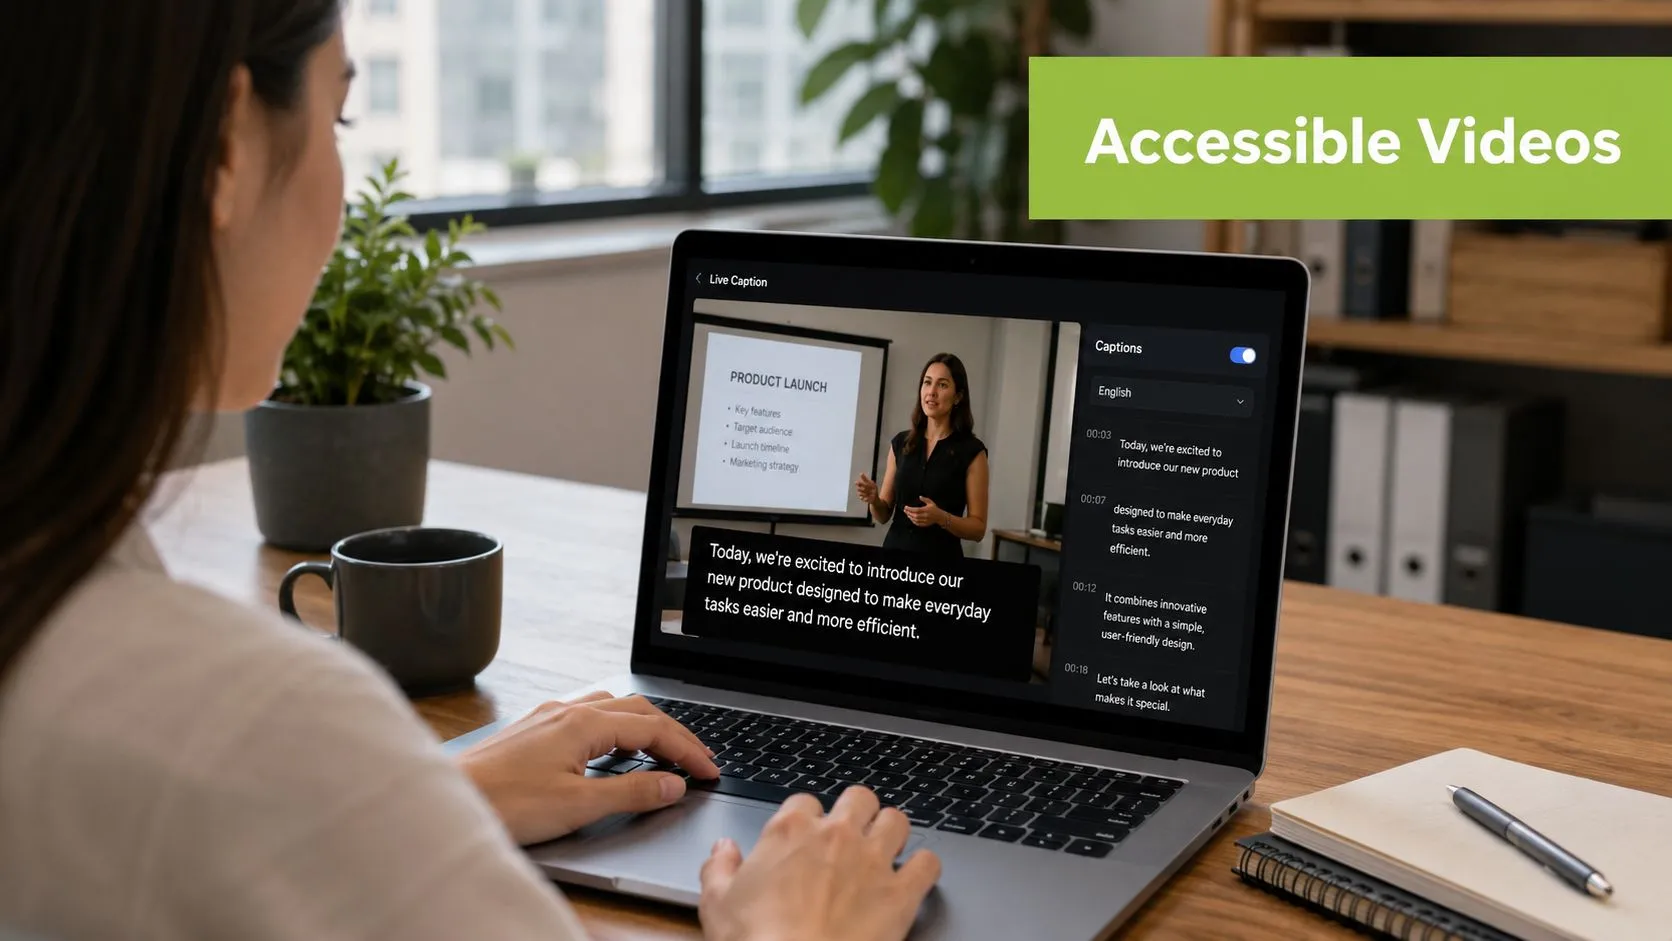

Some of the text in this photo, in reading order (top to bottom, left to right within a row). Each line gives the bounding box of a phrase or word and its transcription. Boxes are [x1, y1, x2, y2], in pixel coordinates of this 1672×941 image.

[710, 274, 768, 288] Live Caption
[1096, 340, 1142, 354] Captions
[730, 371, 827, 393] PRODUCT LAUNCH
[1099, 386, 1132, 399] English
[735, 405, 781, 418] Key features
[734, 422, 793, 436] Target audience
[1086, 429, 1112, 440] 00:03
[731, 440, 789, 454] Launch timeline
[1120, 439, 1222, 457] Today, we're excited to
[730, 457, 799, 474] Marketing strategy
[1118, 457, 1238, 478] introduce our new product
[1081, 494, 1106, 504] 00:07
[1114, 505, 1234, 528] designed to make everyday
[1112, 524, 1208, 543] tasks easier and more
[1110, 544, 1150, 557] efficient.
[710, 543, 964, 588] Today, we're excited to introduce our
[1073, 581, 1096, 593] 00:12
[707, 571, 991, 623] new product designed to make everyday
[1106, 592, 1207, 614] It combines innovative
[705, 597, 919, 639] tasks easier and more efficient.
[1103, 610, 1140, 624] features
[1143, 617, 1162, 628] with
[1172, 620, 1204, 634] simple,
[1101, 630, 1195, 651] user-friendly design.
[1065, 663, 1088, 674] 00:18
[1097, 674, 1205, 698] Let's take a look at what
[1095, 693, 1170, 712] makes it special.
